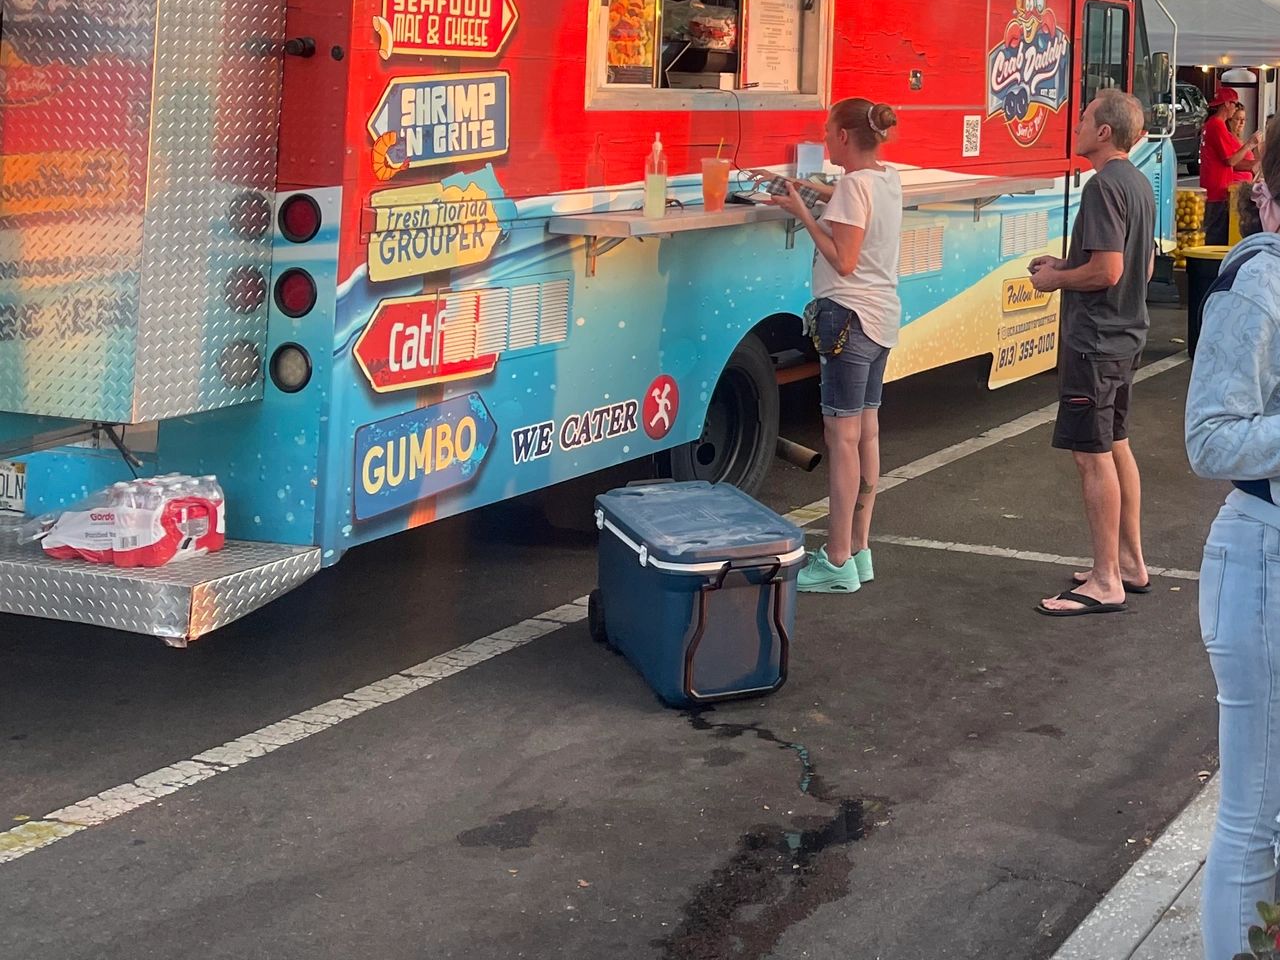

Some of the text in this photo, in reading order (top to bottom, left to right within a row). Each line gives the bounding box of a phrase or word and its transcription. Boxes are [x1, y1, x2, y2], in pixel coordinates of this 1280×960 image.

[393, 13, 489, 47] MAC & CHEESE
[991, 34, 1067, 95] Crab Daddy's
[401, 82, 496, 127] SHRIMP
[433, 119, 495, 154] GRITS
[379, 220, 490, 265] GROUPER
[996, 332, 1056, 373] (813) 359-0100
[512, 399, 639, 465] WE CATER
[361, 415, 478, 496] GUMBO
